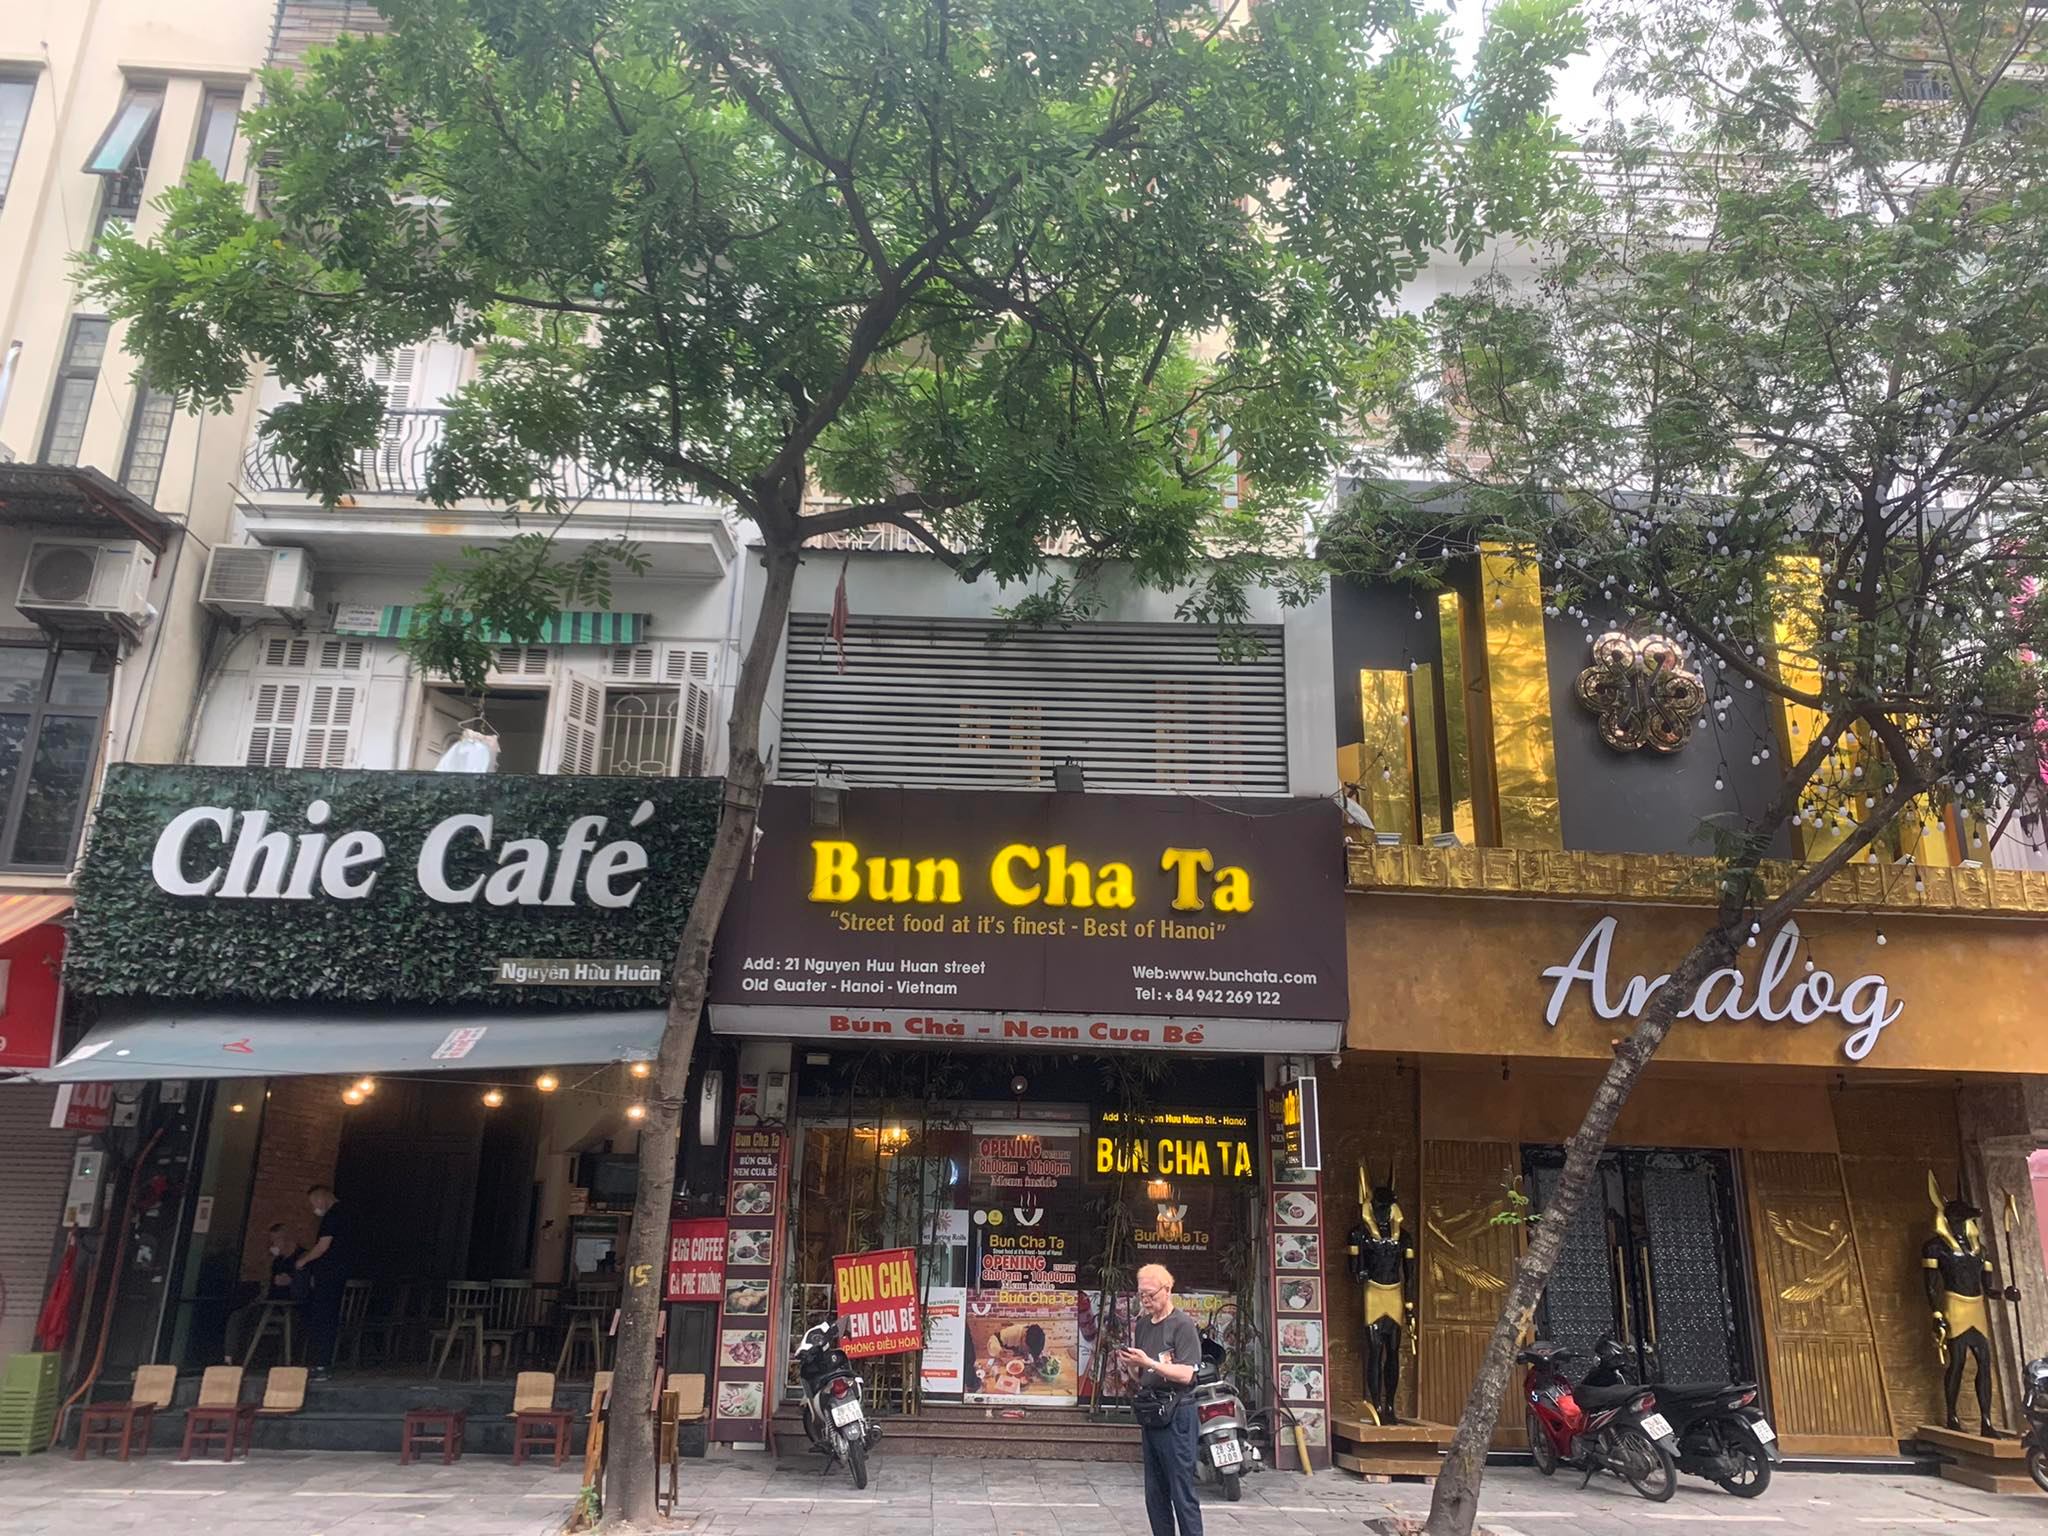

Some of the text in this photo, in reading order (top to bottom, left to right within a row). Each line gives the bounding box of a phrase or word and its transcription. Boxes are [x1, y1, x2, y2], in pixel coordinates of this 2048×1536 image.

[152, 800, 655, 908] Chie Café
[808, 840, 1254, 913] Bun Cha Ta
[903, 913, 945, 933] food
[952, 916, 970, 933] at
[978, 916, 1005, 934] it's
[1013, 917, 1065, 936] finest
[1084, 918, 1127, 937] Best
[1134, 919, 1155, 938] of
[615, 964, 661, 981] Huân
[784, 958, 800, 971] 21
[805, 958, 860, 974] Nguyen
[867, 959, 895, 972] Huu
[900, 960, 938, 973] Huan
[944, 961, 986, 974] street
[742, 978, 768, 991] Old
[774, 979, 827, 992] Quater
[841, 981, 884, 993] Hanoi
[897, 981, 957, 994] Vietnam
[1196, 990, 1223, 1003] 942
[1226, 991, 1253, 1004] 269
[1257, 992, 1280, 1005] 122
[830, 1016, 891, 1033] Bún
[905, 1017, 965, 1036] Chả
[1004, 1021, 1079, 1040] Nem
[1089, 1023, 1150, 1042] Cua
[1163, 1024, 1205, 1044] Bể
[753, 1131, 769, 1146] Cha
[980, 1139, 1042, 1159] OPENING
[1097, 1138, 1252, 1176] BUN CHA TA
[733, 1167, 749, 1176] NEM
[751, 1168, 766, 1176] CUA
[980, 1160, 1018, 1174] 8h00am
[1027, 1160, 1071, 1177] 10h00pm
[991, 1175, 1023, 1187] Menu
[989, 1235, 1065, 1249] Bun Cha Ta
[1134, 1230, 1160, 1241] Bun
[1193, 1231, 1209, 1243] Ta
[672, 1237, 725, 1261] EGG COFFEE
[983, 1255, 1046, 1270] OPENING
[629, 1264, 653, 1287] 15
[838, 1251, 914, 1304] BÚN CHẢ
[982, 1271, 1022, 1281] 8h00am
[1031, 1271, 1076, 1283] 10h00pm
[1000, 1291, 1075, 1305] Bun Cha Ta
[841, 1297, 916, 1338] EM CUA BỂ
